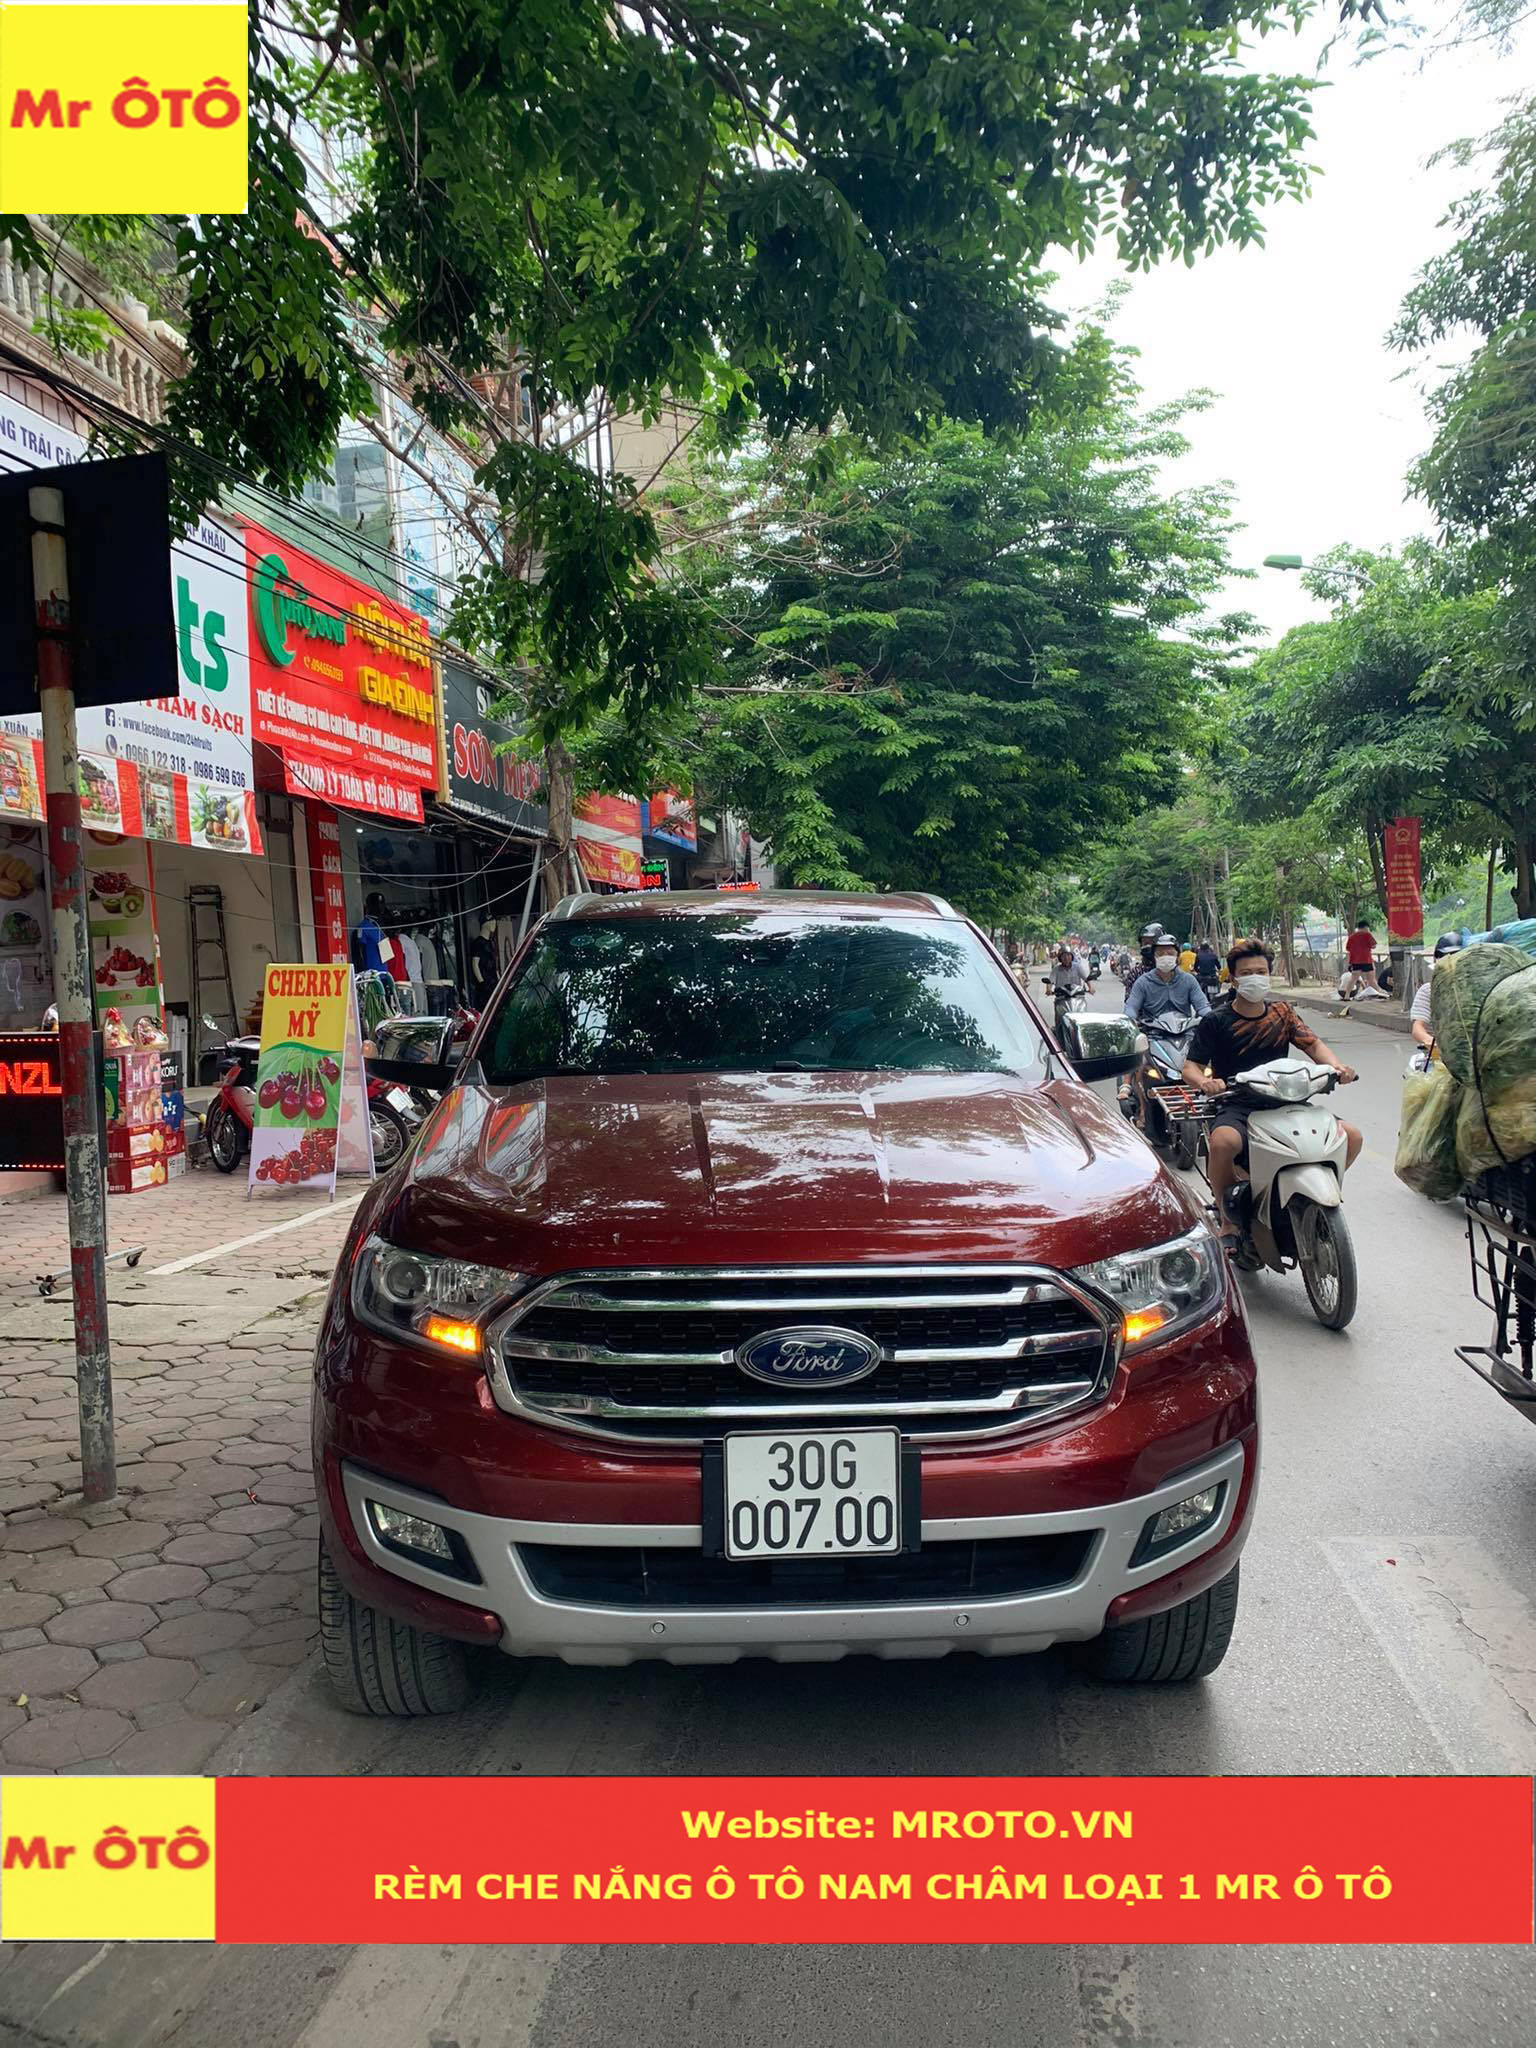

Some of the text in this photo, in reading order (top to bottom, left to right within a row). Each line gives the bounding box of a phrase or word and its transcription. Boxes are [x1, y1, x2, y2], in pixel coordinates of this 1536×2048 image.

[20, 426, 51, 460] TRÁI
[201, 703, 244, 735] SẠCH
[126, 744, 149, 767] 0966
[152, 750, 168, 770] 122
[170, 755, 186, 774] 318
[193, 760, 213, 781] 0986
[215, 766, 230, 784] 599
[232, 772, 245, 788] 636
[267, 970, 347, 997] CHERRY
[287, 1002, 320, 1038] MỸ
[772, 1341, 845, 1372] Ford
[768, 1439, 857, 1491] 30G
[732, 1495, 893, 1550] 007.00
